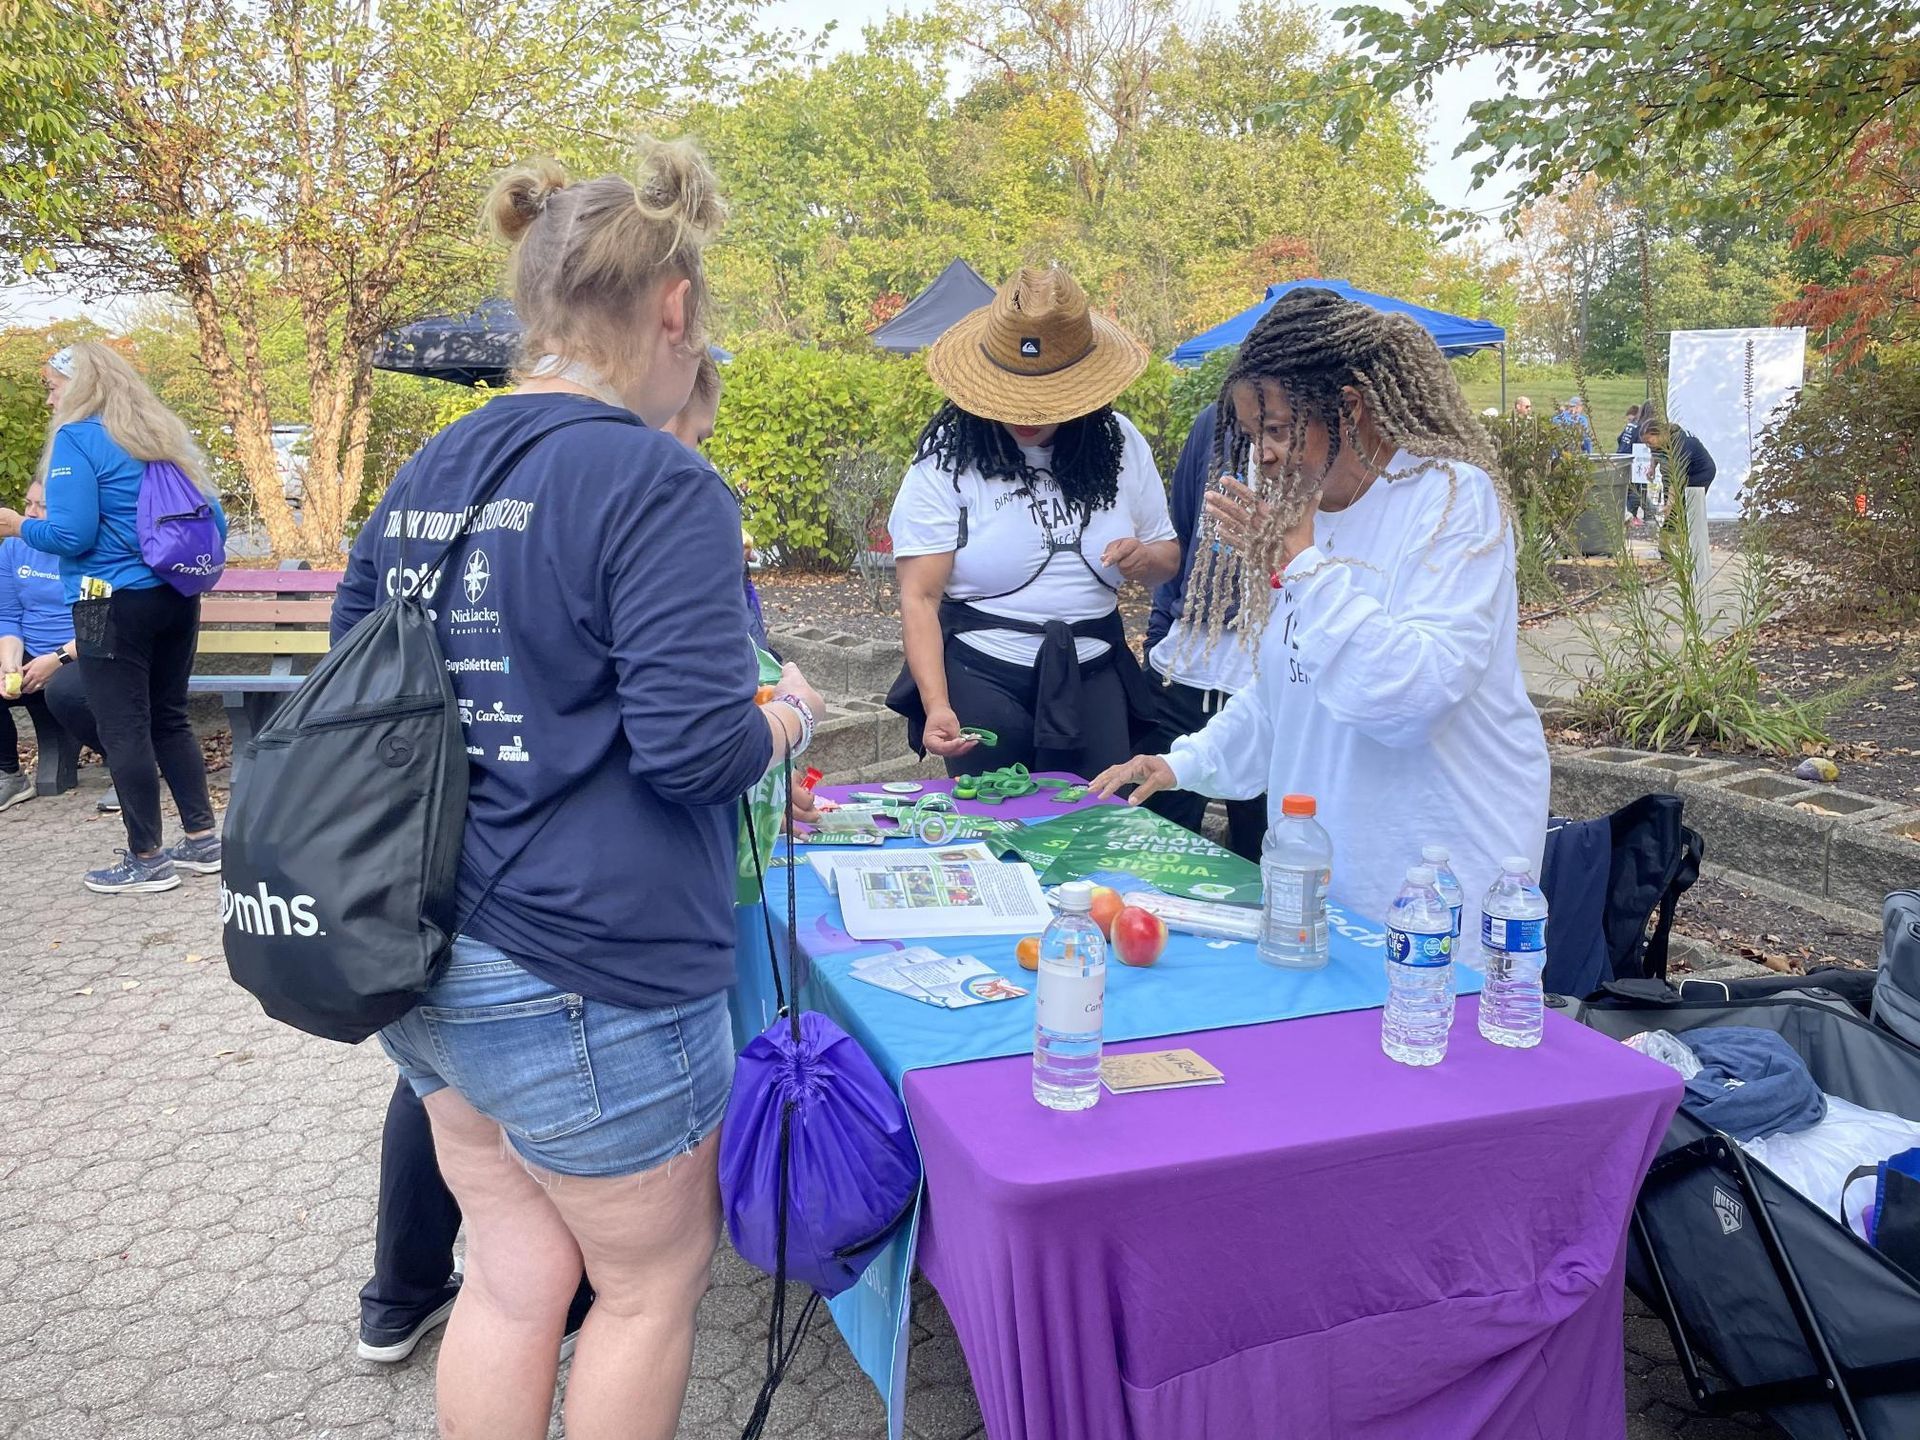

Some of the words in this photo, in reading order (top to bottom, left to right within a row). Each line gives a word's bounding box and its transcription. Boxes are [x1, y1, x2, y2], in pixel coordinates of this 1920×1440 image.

[421, 513, 454, 541] YOU
[1028, 498, 1084, 529] TEAM
[476, 709, 524, 723] CareSource
[1097, 857, 1219, 878] STIGMA.
[1716, 1191, 1740, 1220] QUEST
